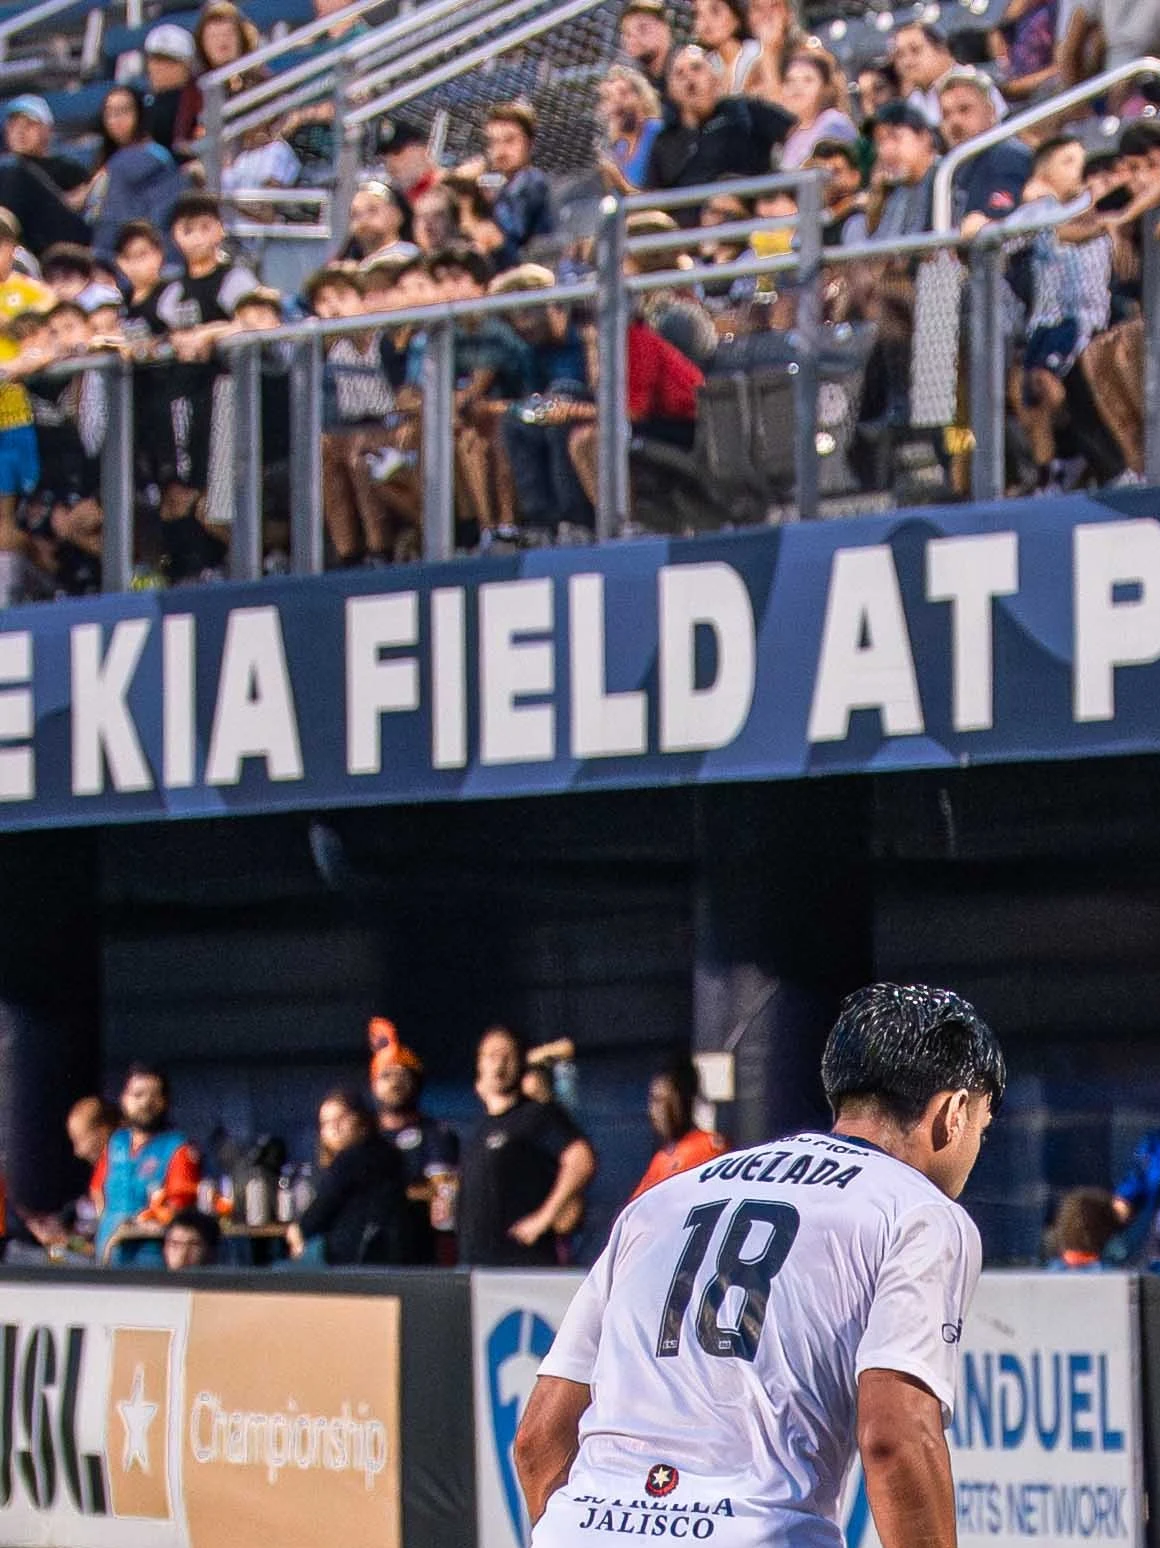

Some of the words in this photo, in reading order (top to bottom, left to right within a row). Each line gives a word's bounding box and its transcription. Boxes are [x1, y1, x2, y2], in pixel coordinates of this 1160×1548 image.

[70, 606, 304, 796] KIA
[345, 561, 757, 775] FIELD
[807, 531, 1019, 744] AT
[656, 1198, 801, 1363] 18
[190, 1392, 387, 1490] Championship
[951, 1352, 1125, 1453] NDUEL
[579, 1508, 715, 1539] JALISCO
[957, 1480, 1000, 1536] RTS
